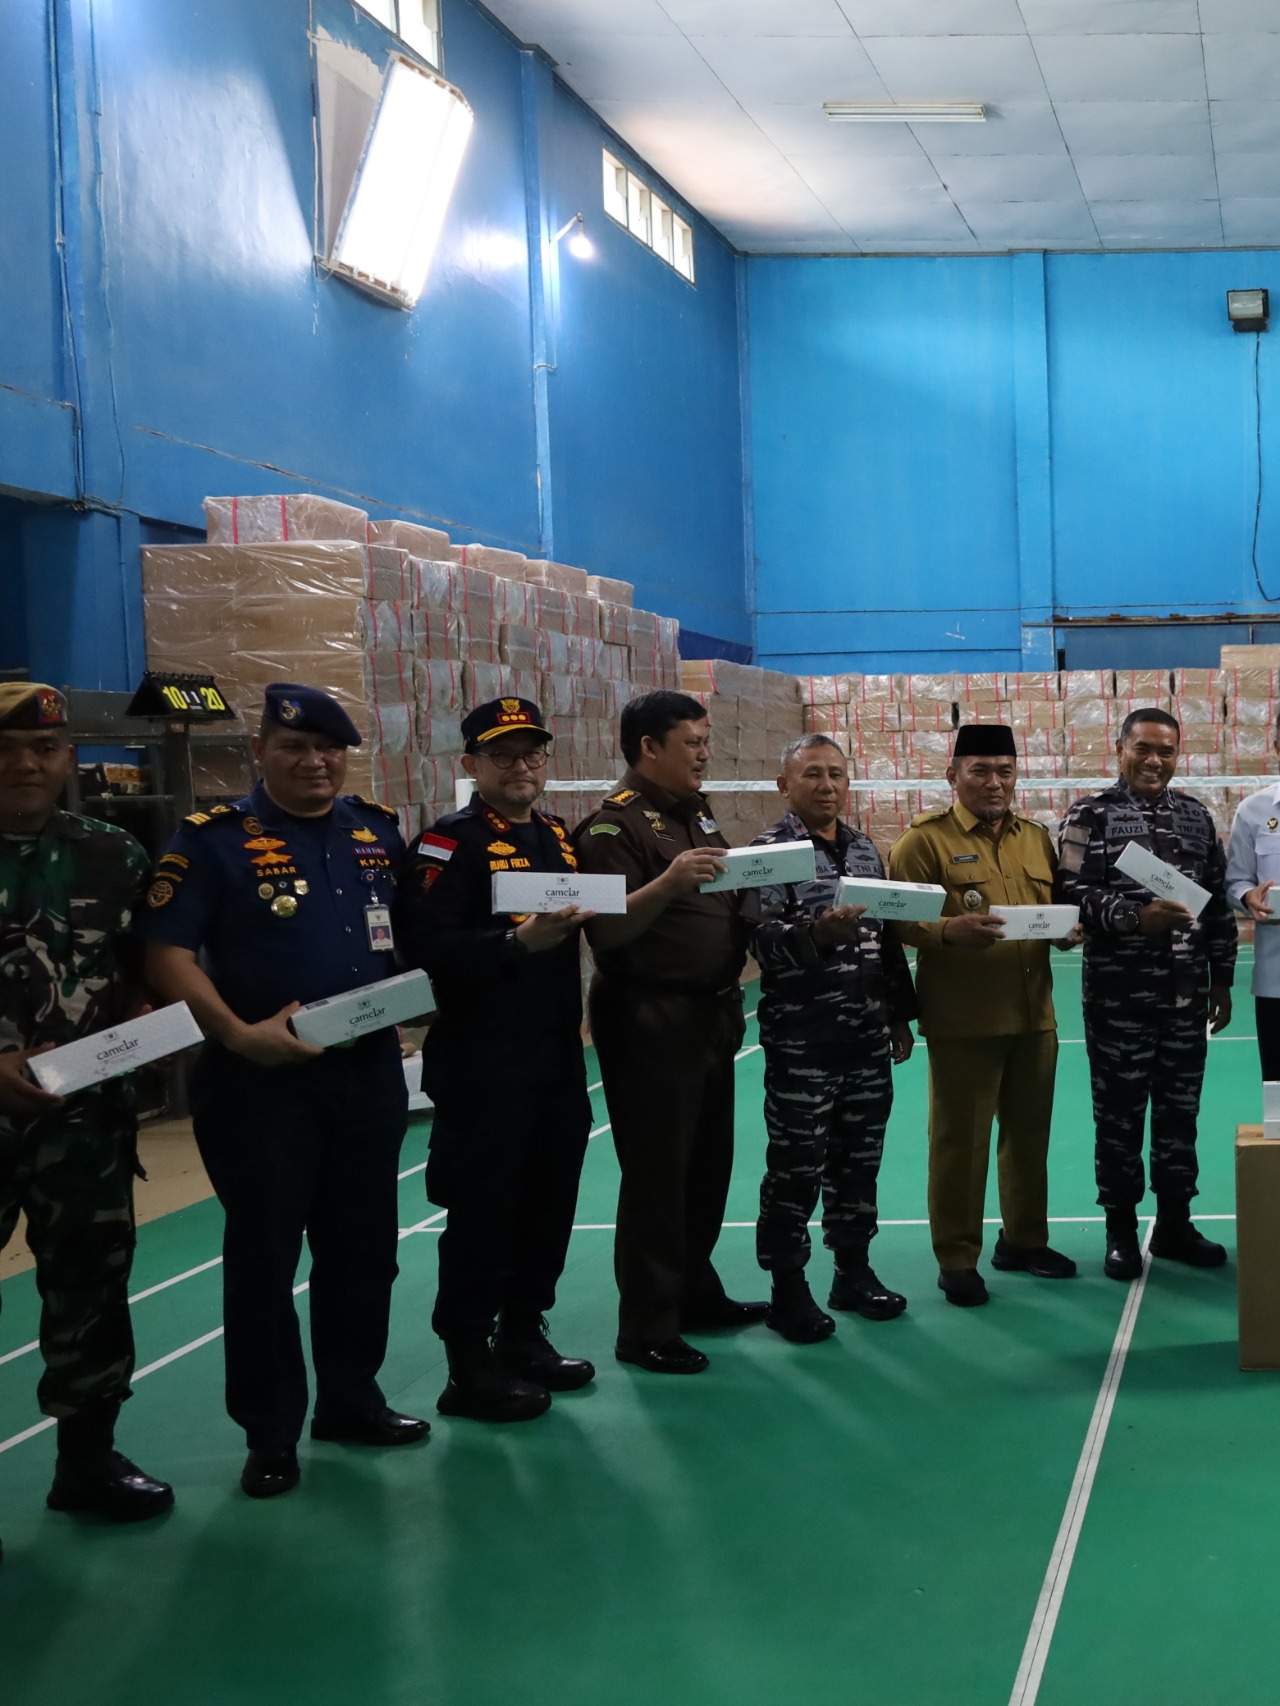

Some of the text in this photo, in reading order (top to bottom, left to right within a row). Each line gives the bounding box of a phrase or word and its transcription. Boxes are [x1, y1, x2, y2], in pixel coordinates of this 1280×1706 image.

[163, 686, 188, 710] 10
[201, 687, 226, 711] 20
[1111, 826, 1143, 836] FAUZI
[1177, 825, 1206, 836] TNI AL
[359, 858, 390, 867] KPLP
[489, 857, 531, 871] RURU FIRZA
[256, 866, 297, 877] SABAR
[854, 864, 872, 873] TNI
[545, 887, 580, 897] camclar
[96, 1039, 139, 1061] camclar
